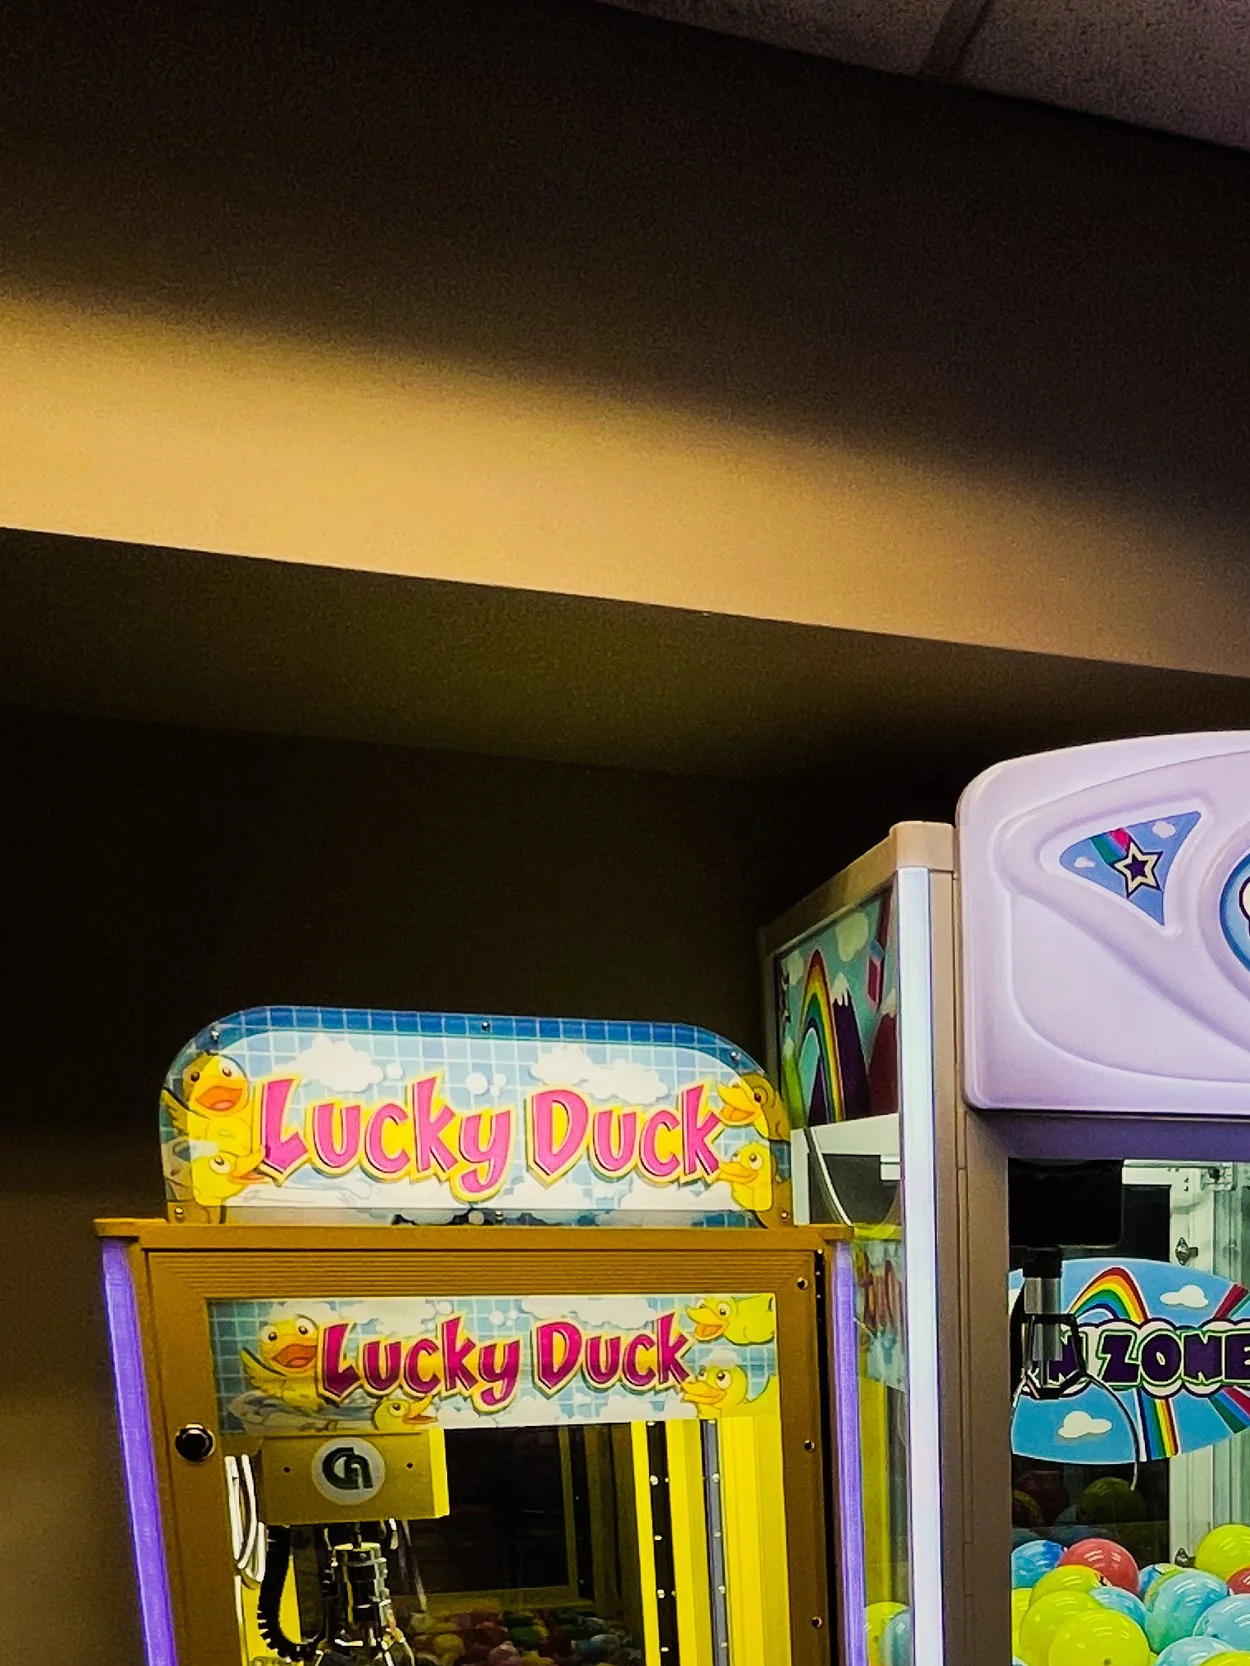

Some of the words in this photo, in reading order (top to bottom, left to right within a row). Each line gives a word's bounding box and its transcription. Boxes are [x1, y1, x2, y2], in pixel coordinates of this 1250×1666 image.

[257, 1074, 514, 1196] Lucky
[529, 1083, 722, 1178] Duck
[321, 1316, 521, 1407] Lucky
[534, 1312, 692, 1391] Duck
